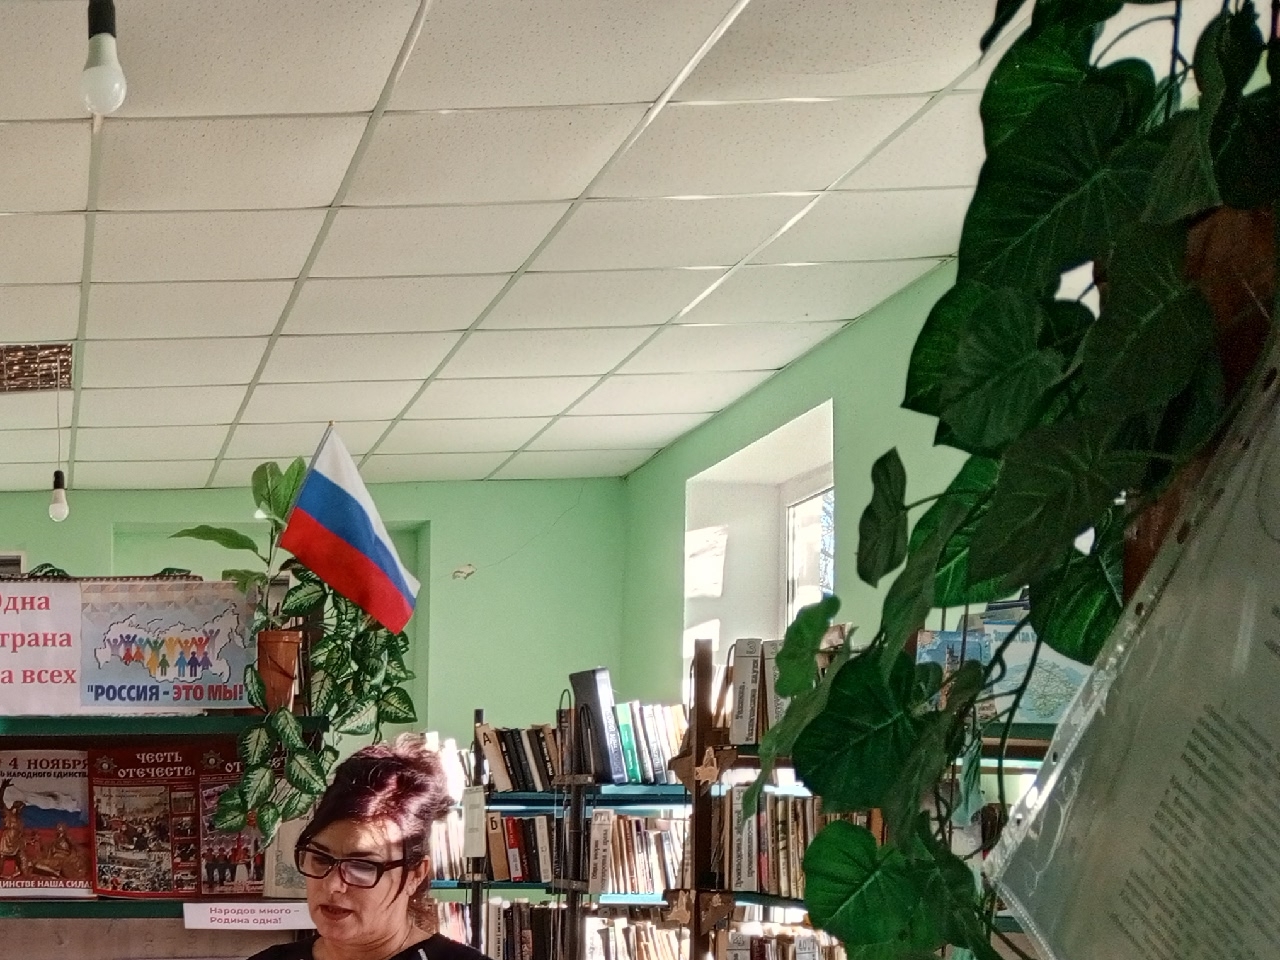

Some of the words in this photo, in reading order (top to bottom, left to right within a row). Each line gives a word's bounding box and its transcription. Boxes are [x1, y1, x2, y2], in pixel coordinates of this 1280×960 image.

[21, 669, 77, 685] всех
[87, 685, 160, 702] "РОССИЯ
[173, 685, 205, 702] ЭТО
[207, 684, 245, 701] МЫ!
[8, 758, 19, 770] 4
[136, 752, 183, 764] ЧЕСТЬ
[53, 771, 89, 779] ЕДИНСТВ
[117, 766, 195, 778] ОТЕЧЕСТВ
[37, 880, 65, 888] НАША
[209, 906, 256, 917] Народов
[258, 908, 291, 917] много
[209, 916, 250, 925] Родина
[252, 916, 282, 926] одна!
